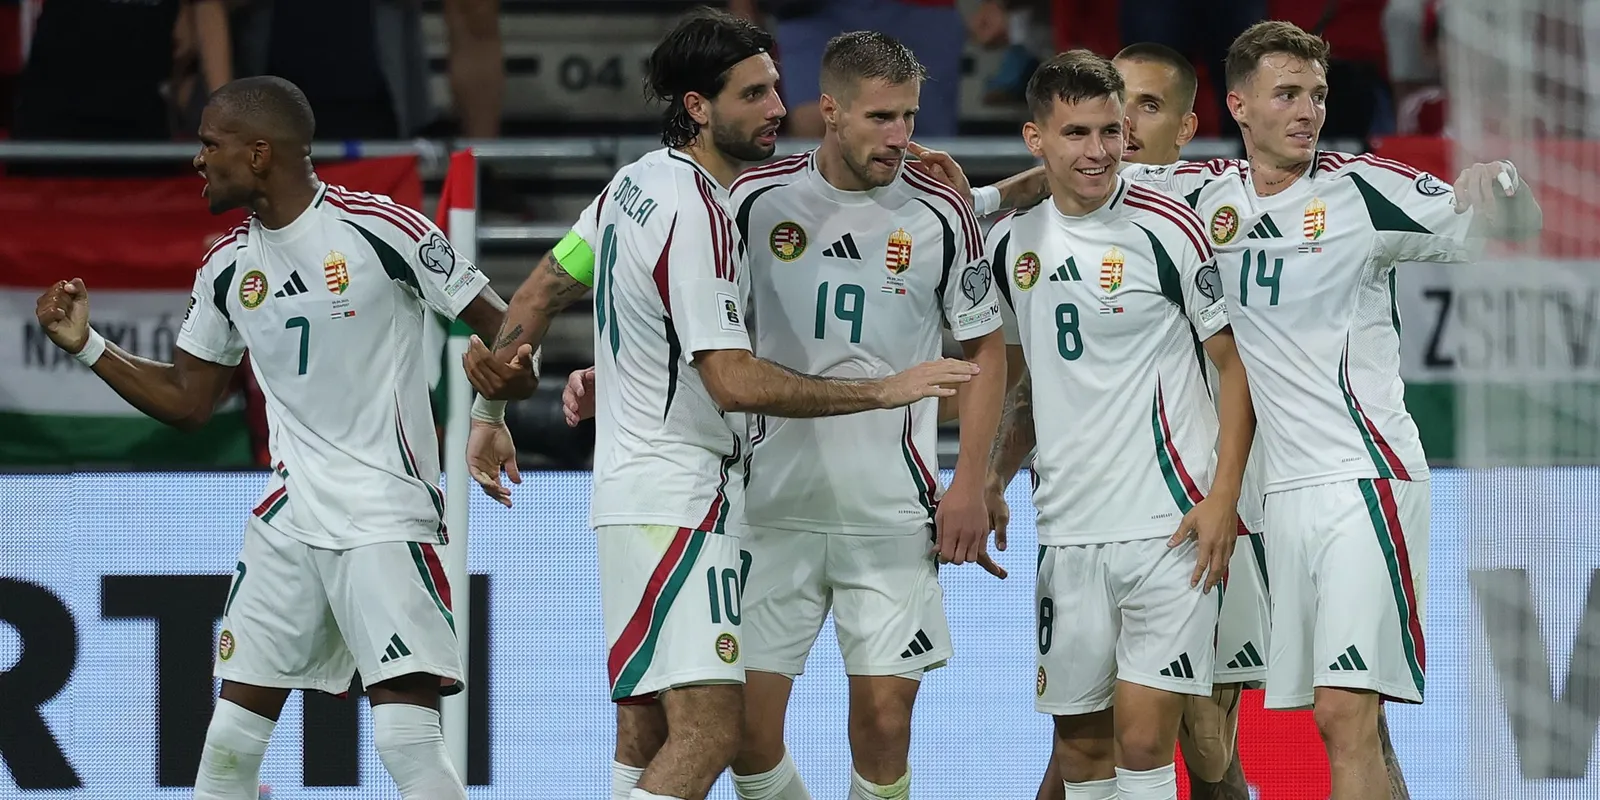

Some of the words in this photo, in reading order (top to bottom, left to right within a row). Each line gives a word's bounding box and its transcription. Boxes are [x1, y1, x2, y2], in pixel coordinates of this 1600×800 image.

[556, 53, 626, 94] 04
[1239, 249, 1284, 307] 14
[814, 281, 866, 344] 19
[1055, 302, 1084, 361] 8
[1421, 287, 1600, 369] ZSITV
[285, 316, 310, 375] 7
[706, 565, 742, 626] 10
[1037, 596, 1054, 656] 8
